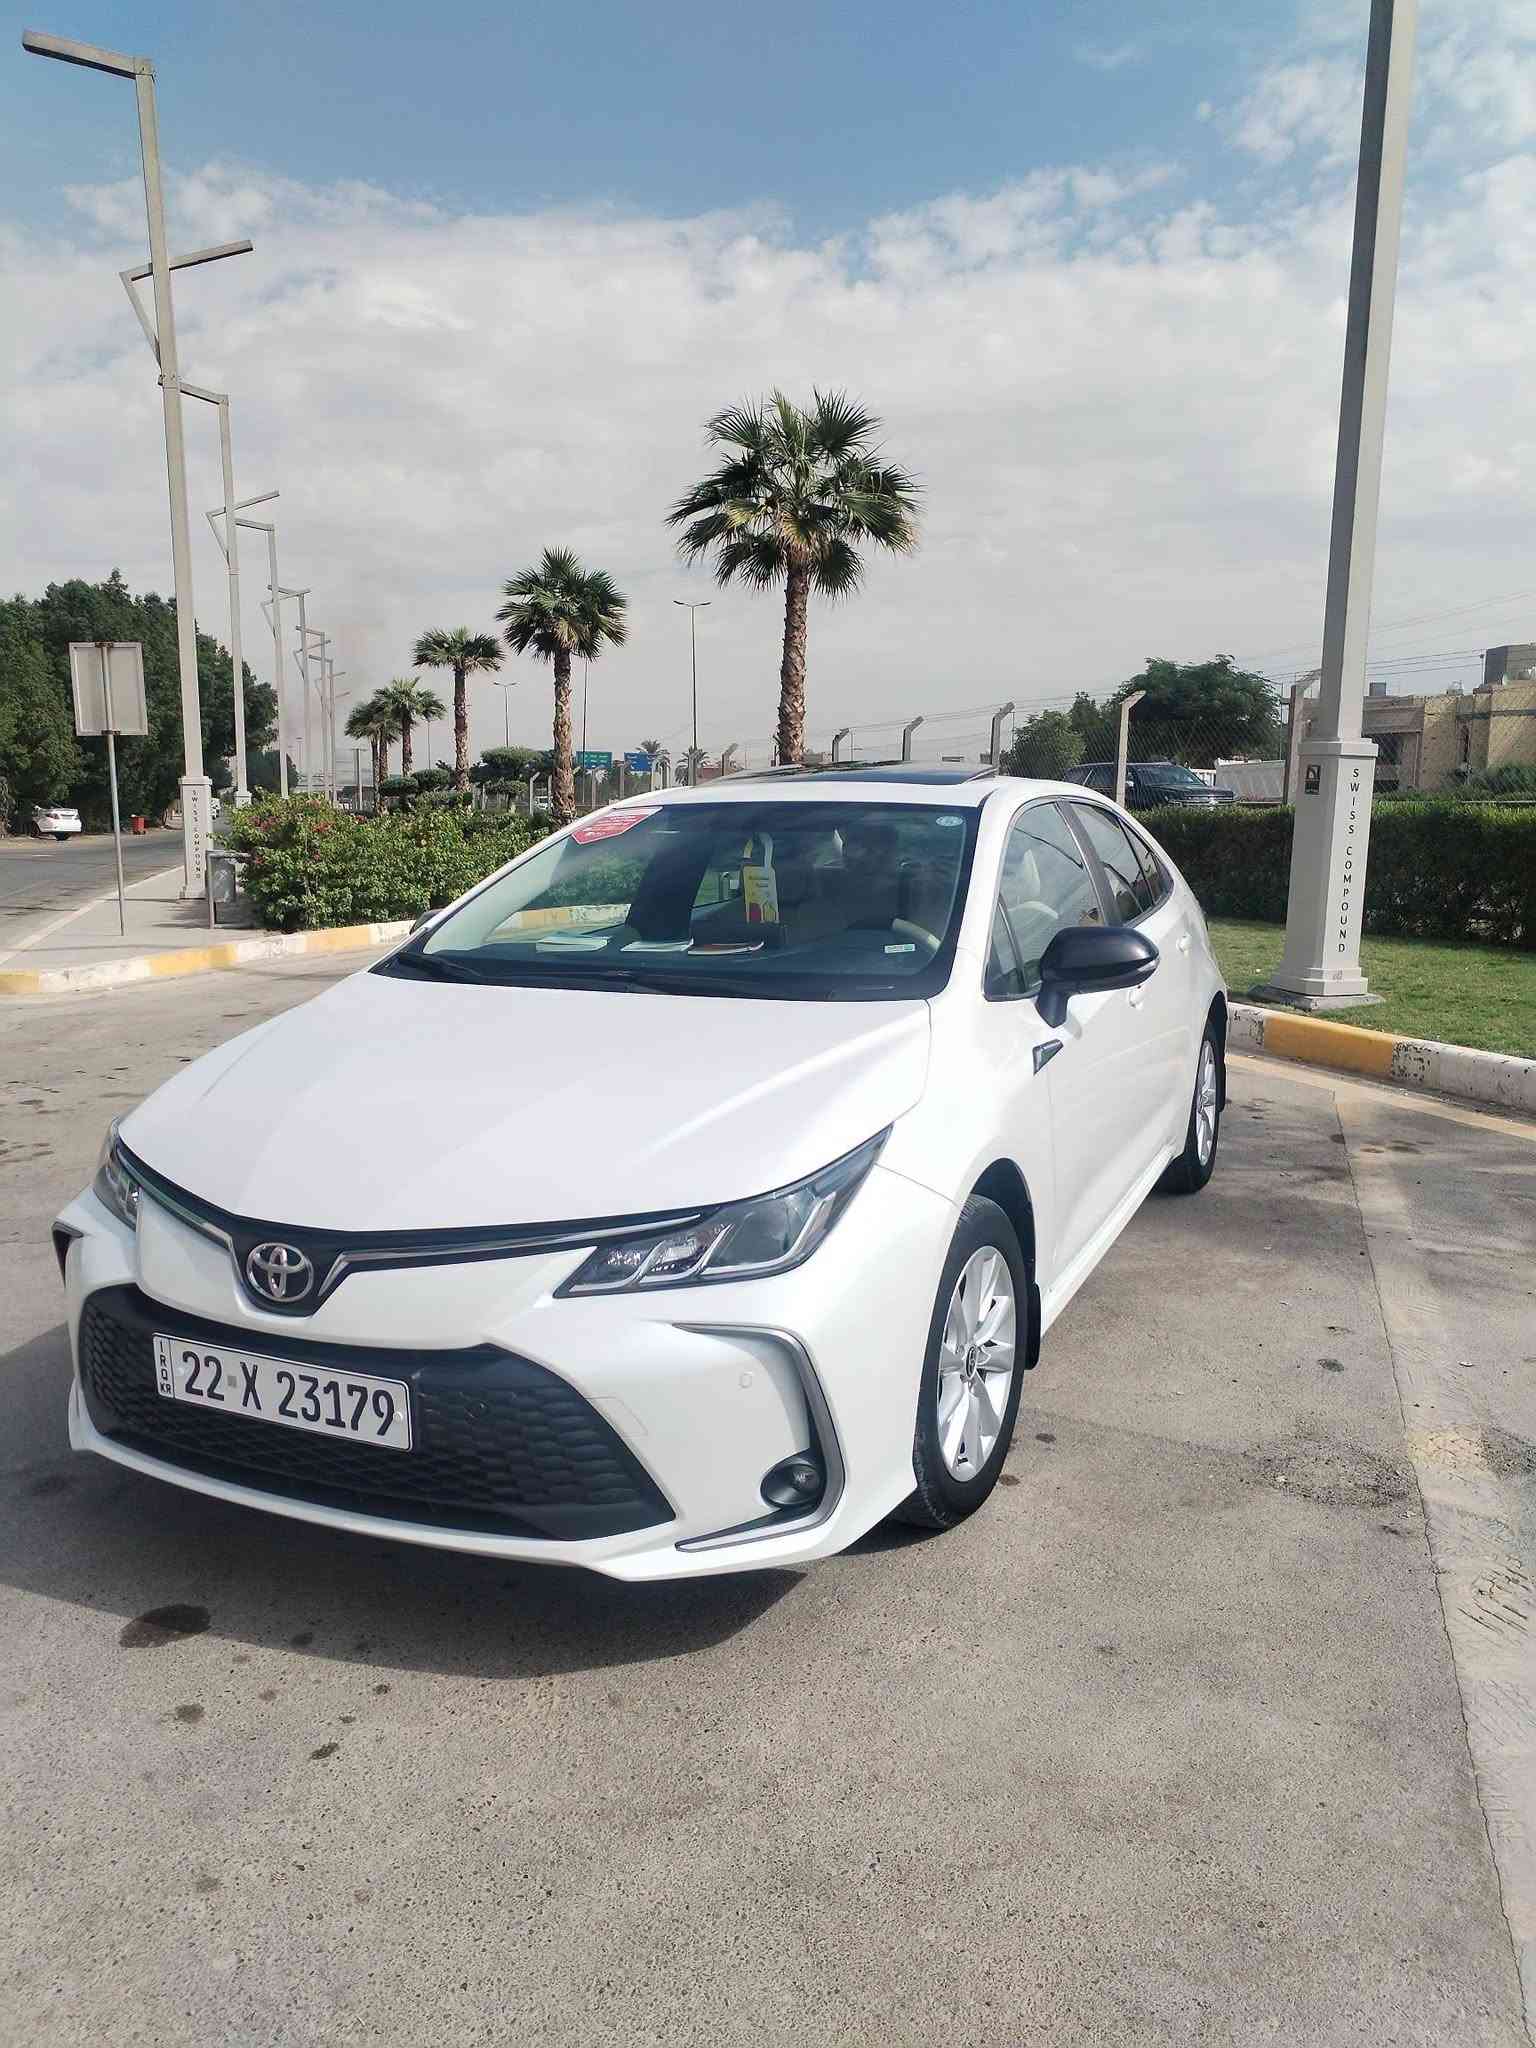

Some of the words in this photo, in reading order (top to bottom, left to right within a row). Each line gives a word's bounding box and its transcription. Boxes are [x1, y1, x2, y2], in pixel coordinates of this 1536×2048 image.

[1347, 768, 1360, 834] SWISS
[1338, 846, 1353, 952] COMPOUND
[182, 1351, 225, 1401] 22
[240, 1361, 262, 1410] X
[276, 1371, 395, 1436] 23179
